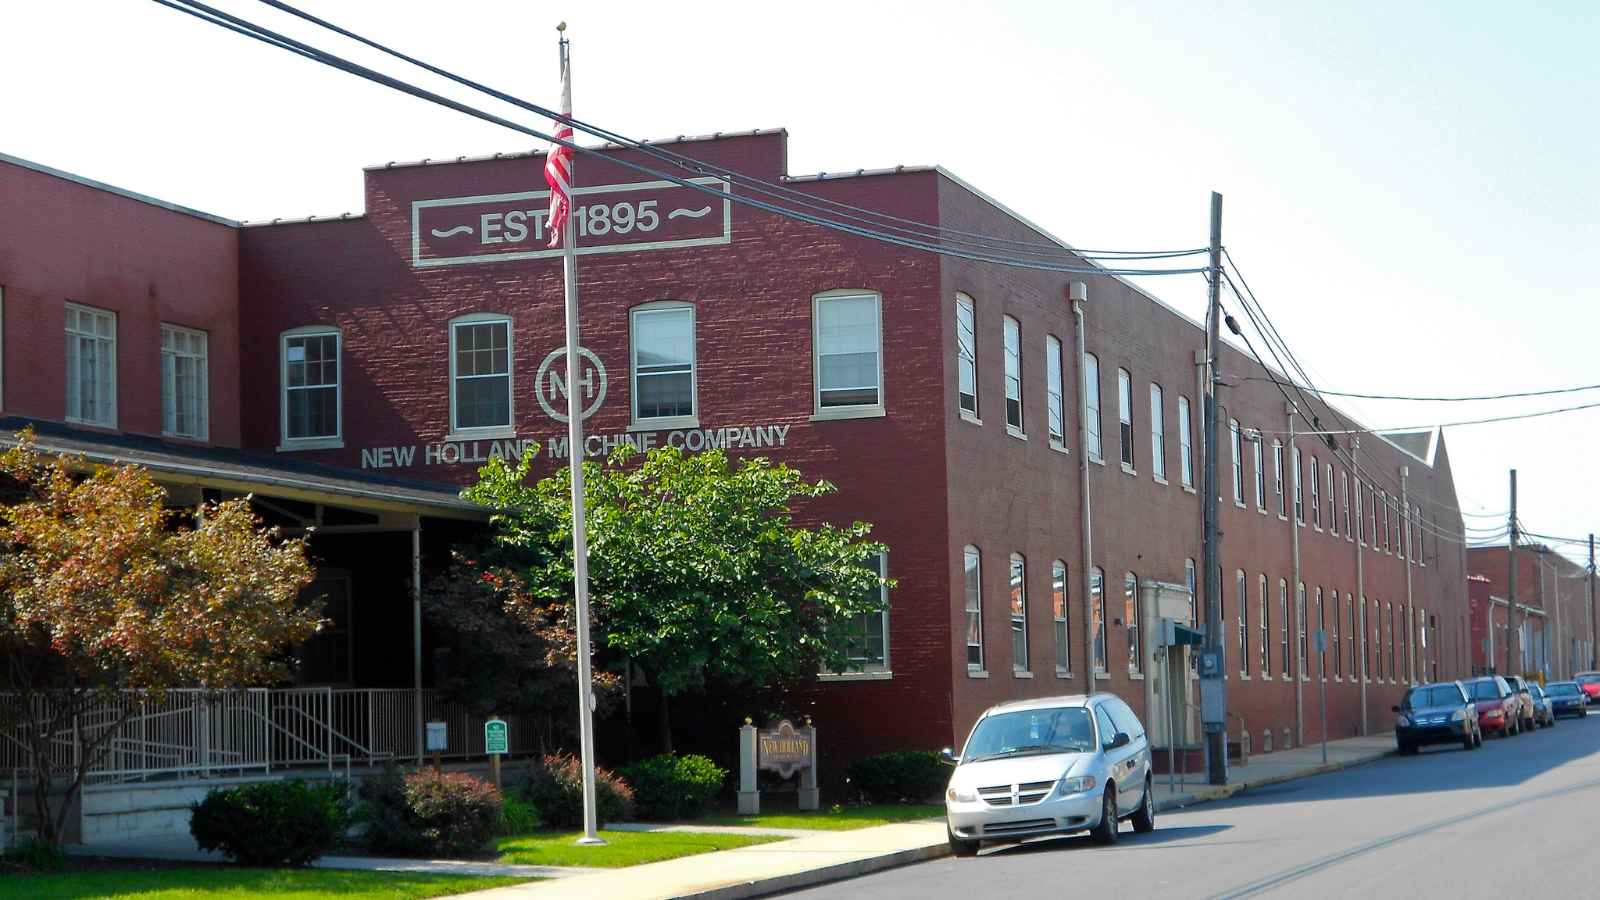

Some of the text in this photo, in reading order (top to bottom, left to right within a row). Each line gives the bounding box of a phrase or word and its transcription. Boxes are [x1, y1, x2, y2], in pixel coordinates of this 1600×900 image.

[573, 200, 659, 237] 1895
[361, 445, 417, 469] NEW
[548, 432, 657, 458] MCHINE
[667, 424, 791, 451] COMPANY
